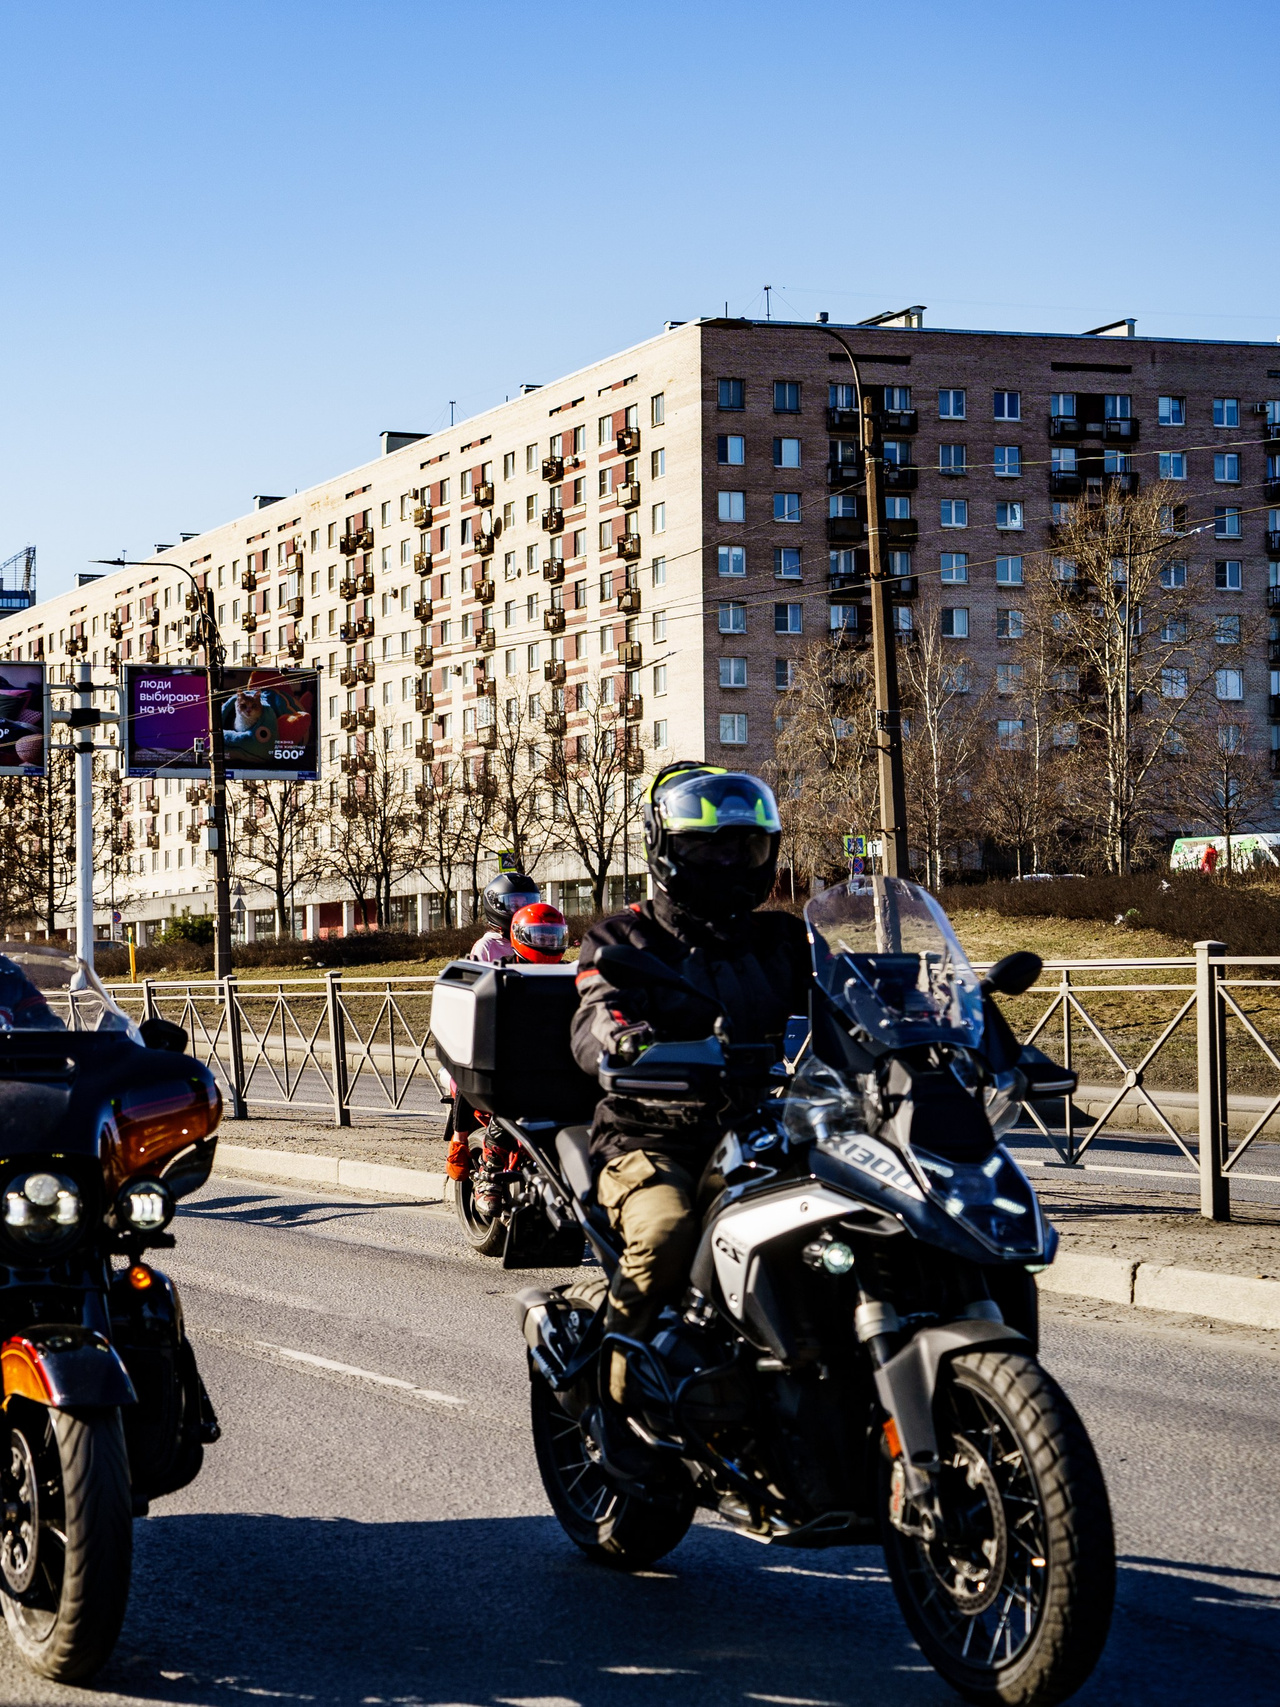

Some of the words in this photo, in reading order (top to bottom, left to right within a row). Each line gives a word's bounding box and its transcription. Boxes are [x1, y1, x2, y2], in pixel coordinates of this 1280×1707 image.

[140, 680, 171, 690] люди
[140, 691, 200, 704] выбирают
[140, 706, 154, 714] на
[157, 704, 175, 714] wb
